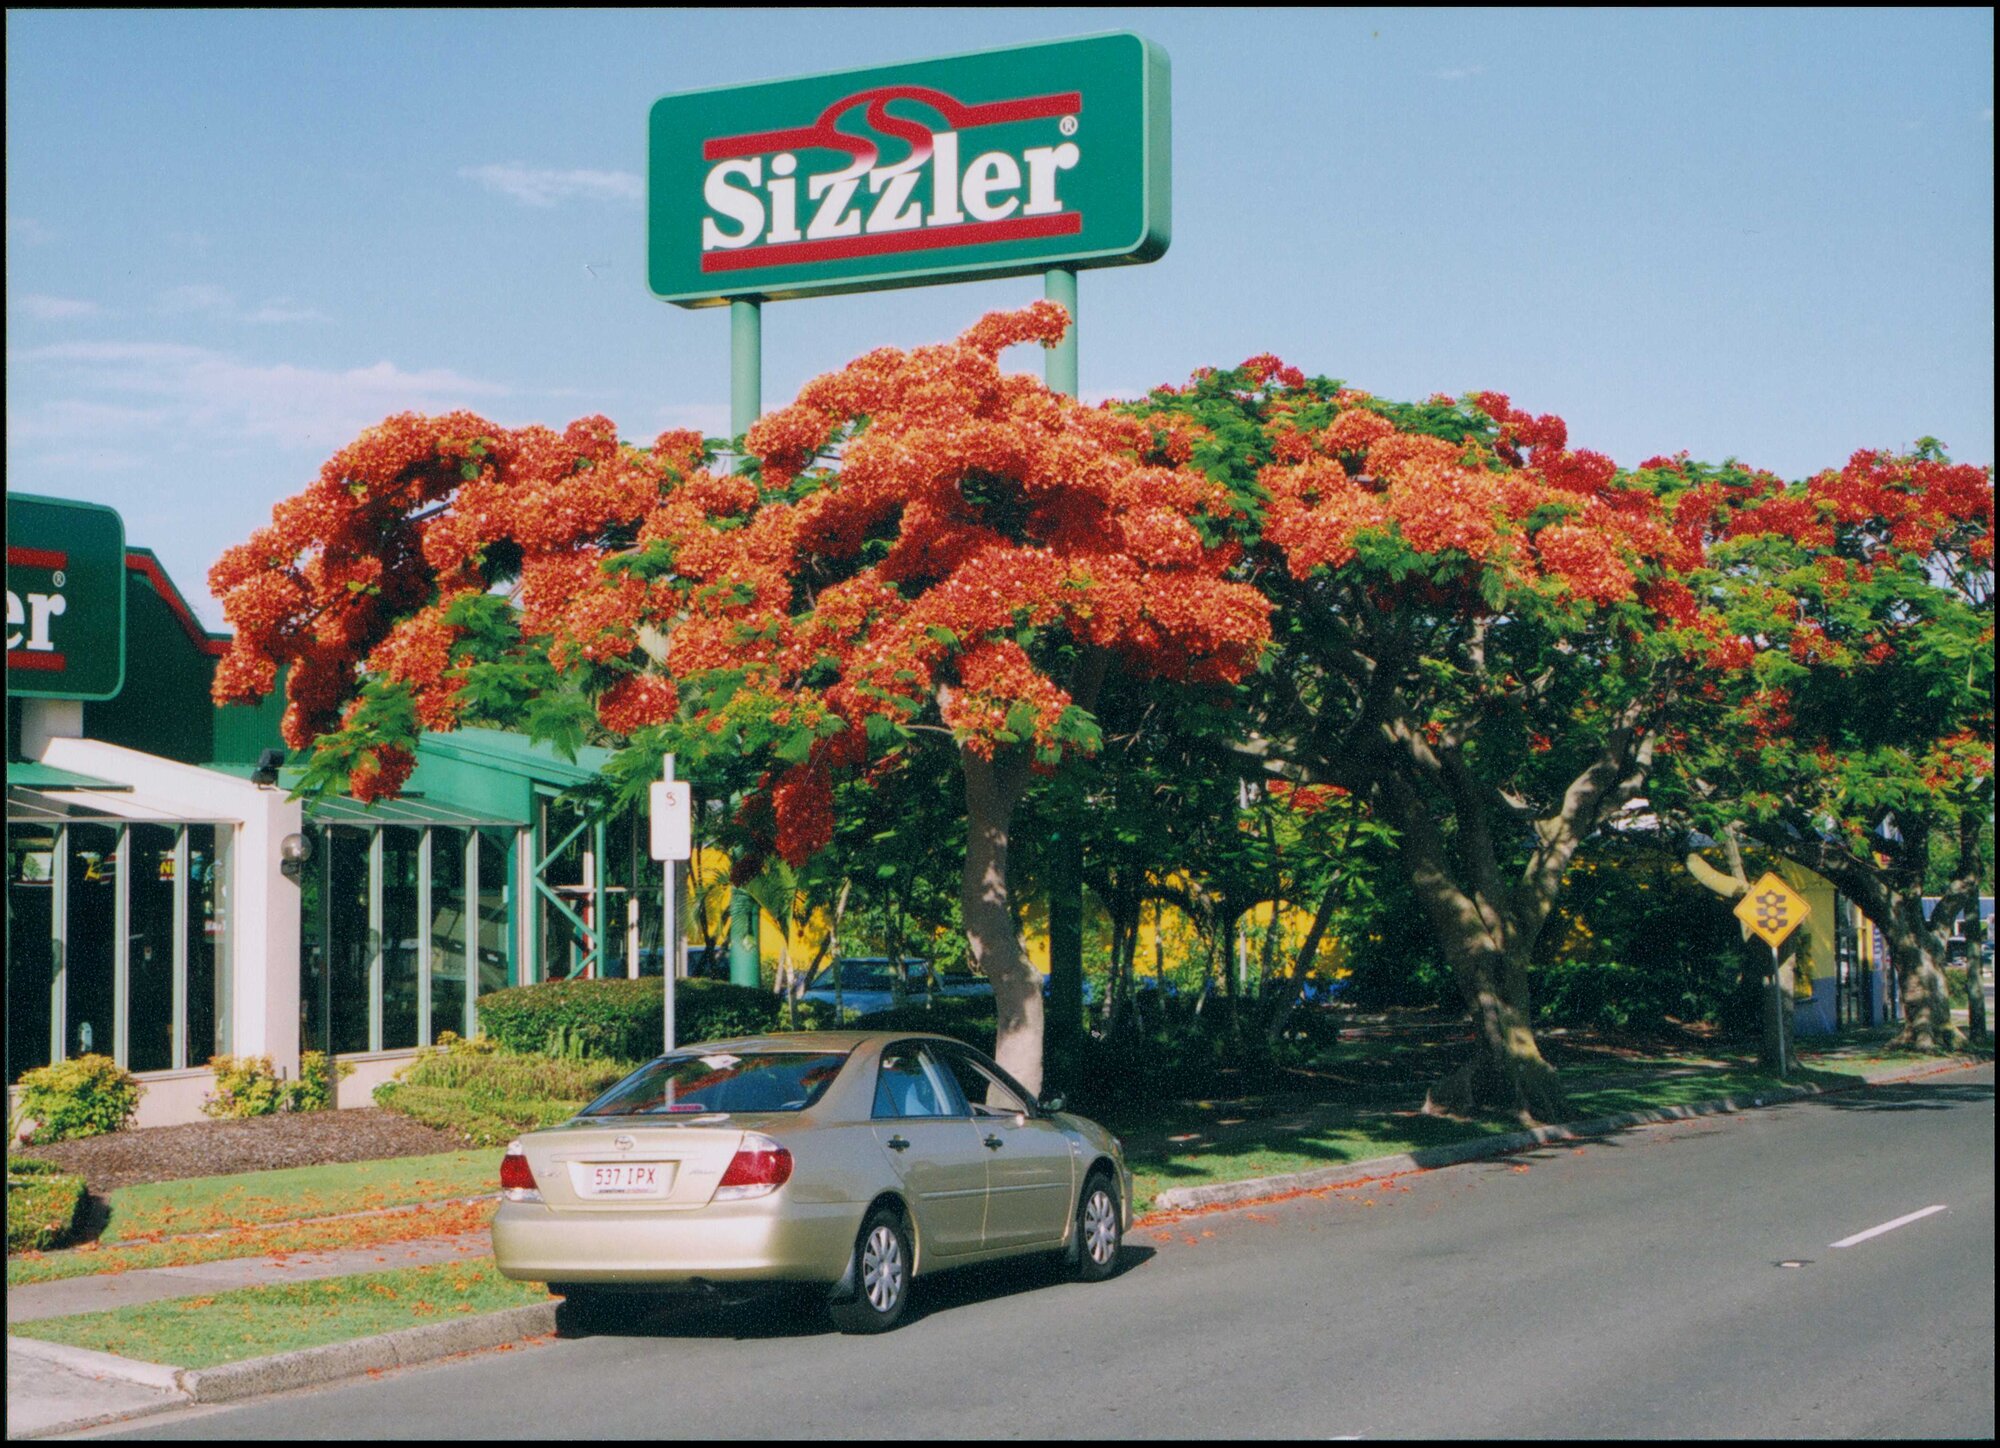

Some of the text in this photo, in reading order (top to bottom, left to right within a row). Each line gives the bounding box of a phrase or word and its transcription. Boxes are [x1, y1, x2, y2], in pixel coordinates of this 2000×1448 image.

[702, 130, 1080, 251] Sizzler
[595, 1168, 655, 1185] 537 IPX
